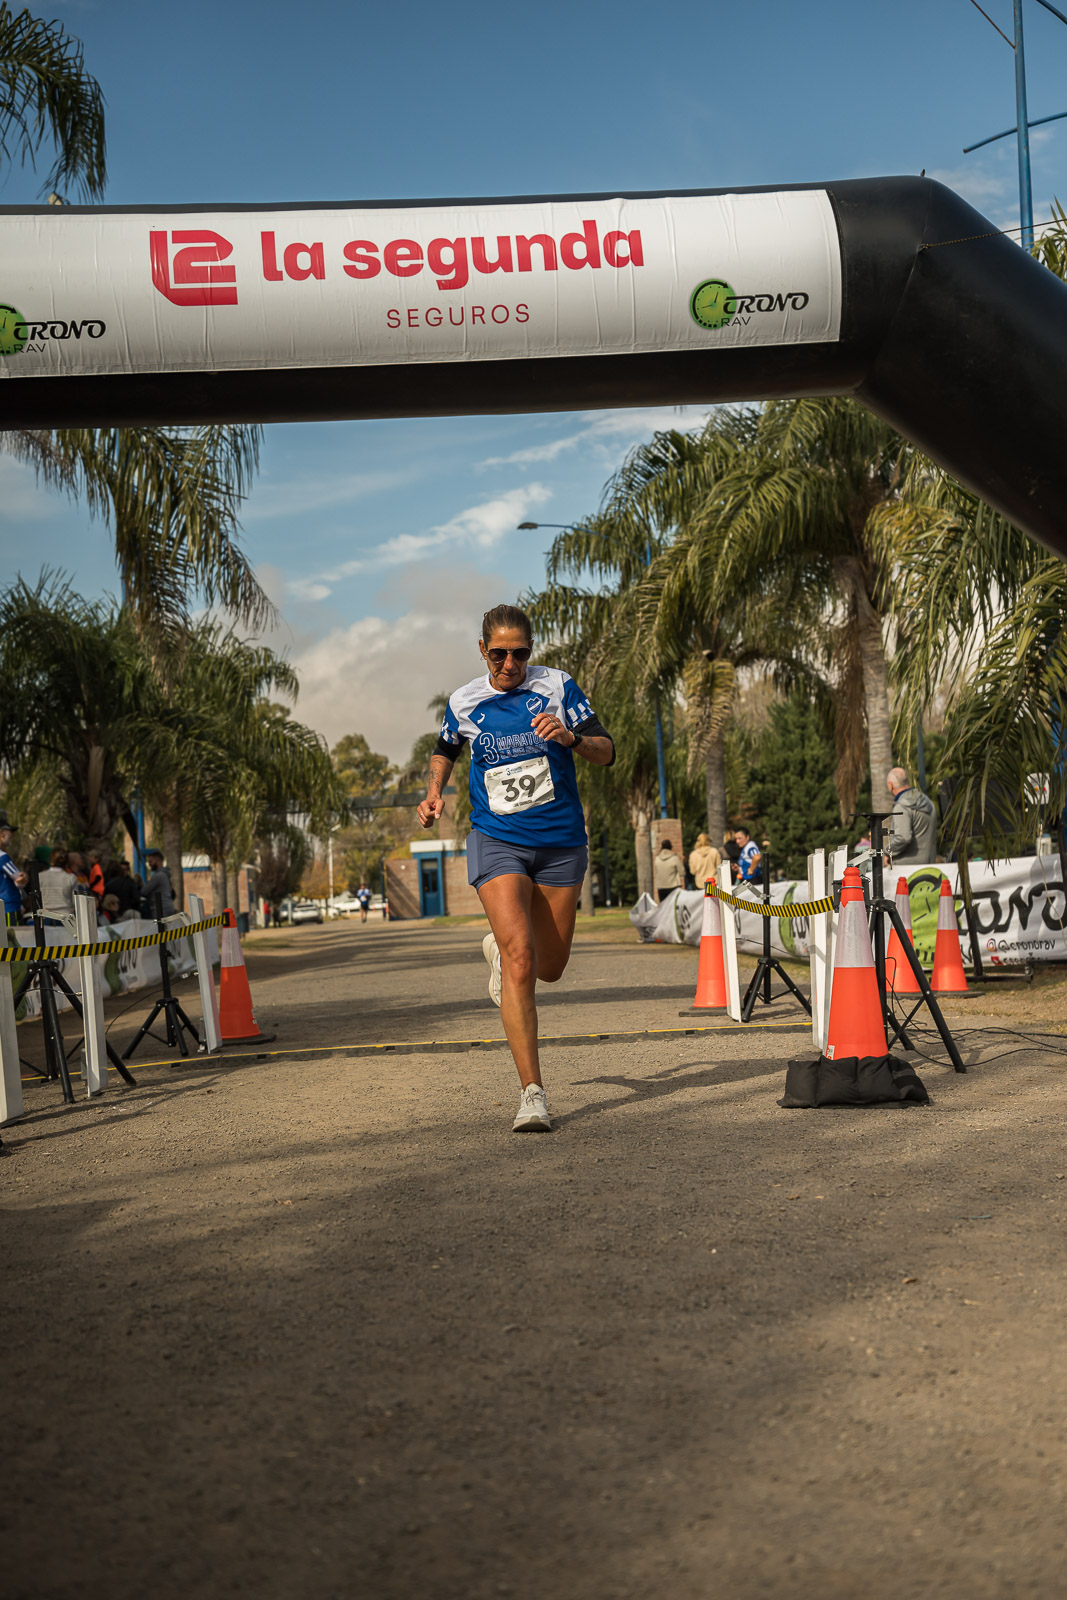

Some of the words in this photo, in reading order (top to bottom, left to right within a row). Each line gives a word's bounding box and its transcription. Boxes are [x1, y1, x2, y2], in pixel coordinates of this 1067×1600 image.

[260, 231, 326, 282] la
[342, 219, 645, 291] segunda
[723, 292, 810, 315] CRONO
[386, 303, 530, 329] SEGUROS
[720, 316, 752, 328] RAV
[13, 320, 107, 341] CRONO
[13, 343, 46, 354] RAV
[479, 732, 500, 765] 3
[501, 774, 536, 803] 39
